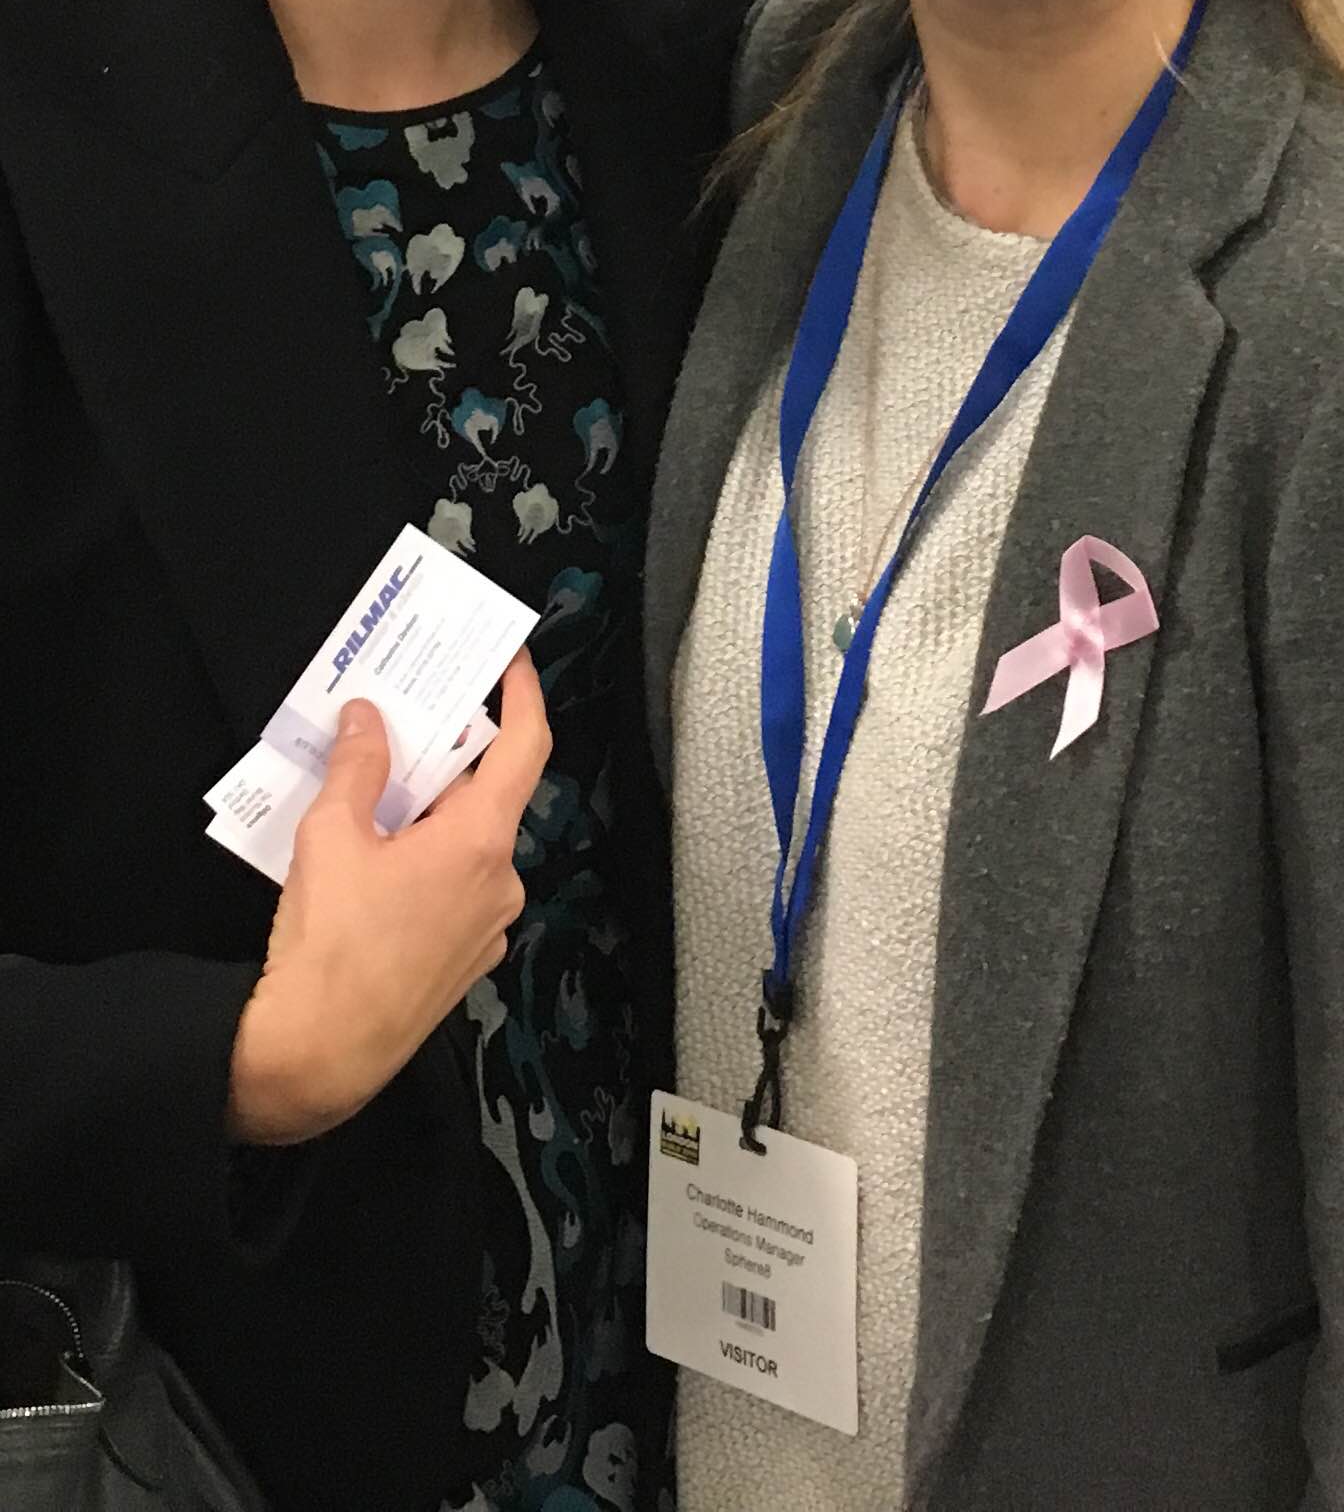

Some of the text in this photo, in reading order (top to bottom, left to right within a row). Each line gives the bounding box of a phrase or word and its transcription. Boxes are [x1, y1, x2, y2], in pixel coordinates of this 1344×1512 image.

[331, 564, 409, 675] RILMAC
[686, 1183, 814, 1245] Charlotte Hammond
[692, 1211, 806, 1267] Operations Manager
[718, 1339, 779, 1379] VISITOR
